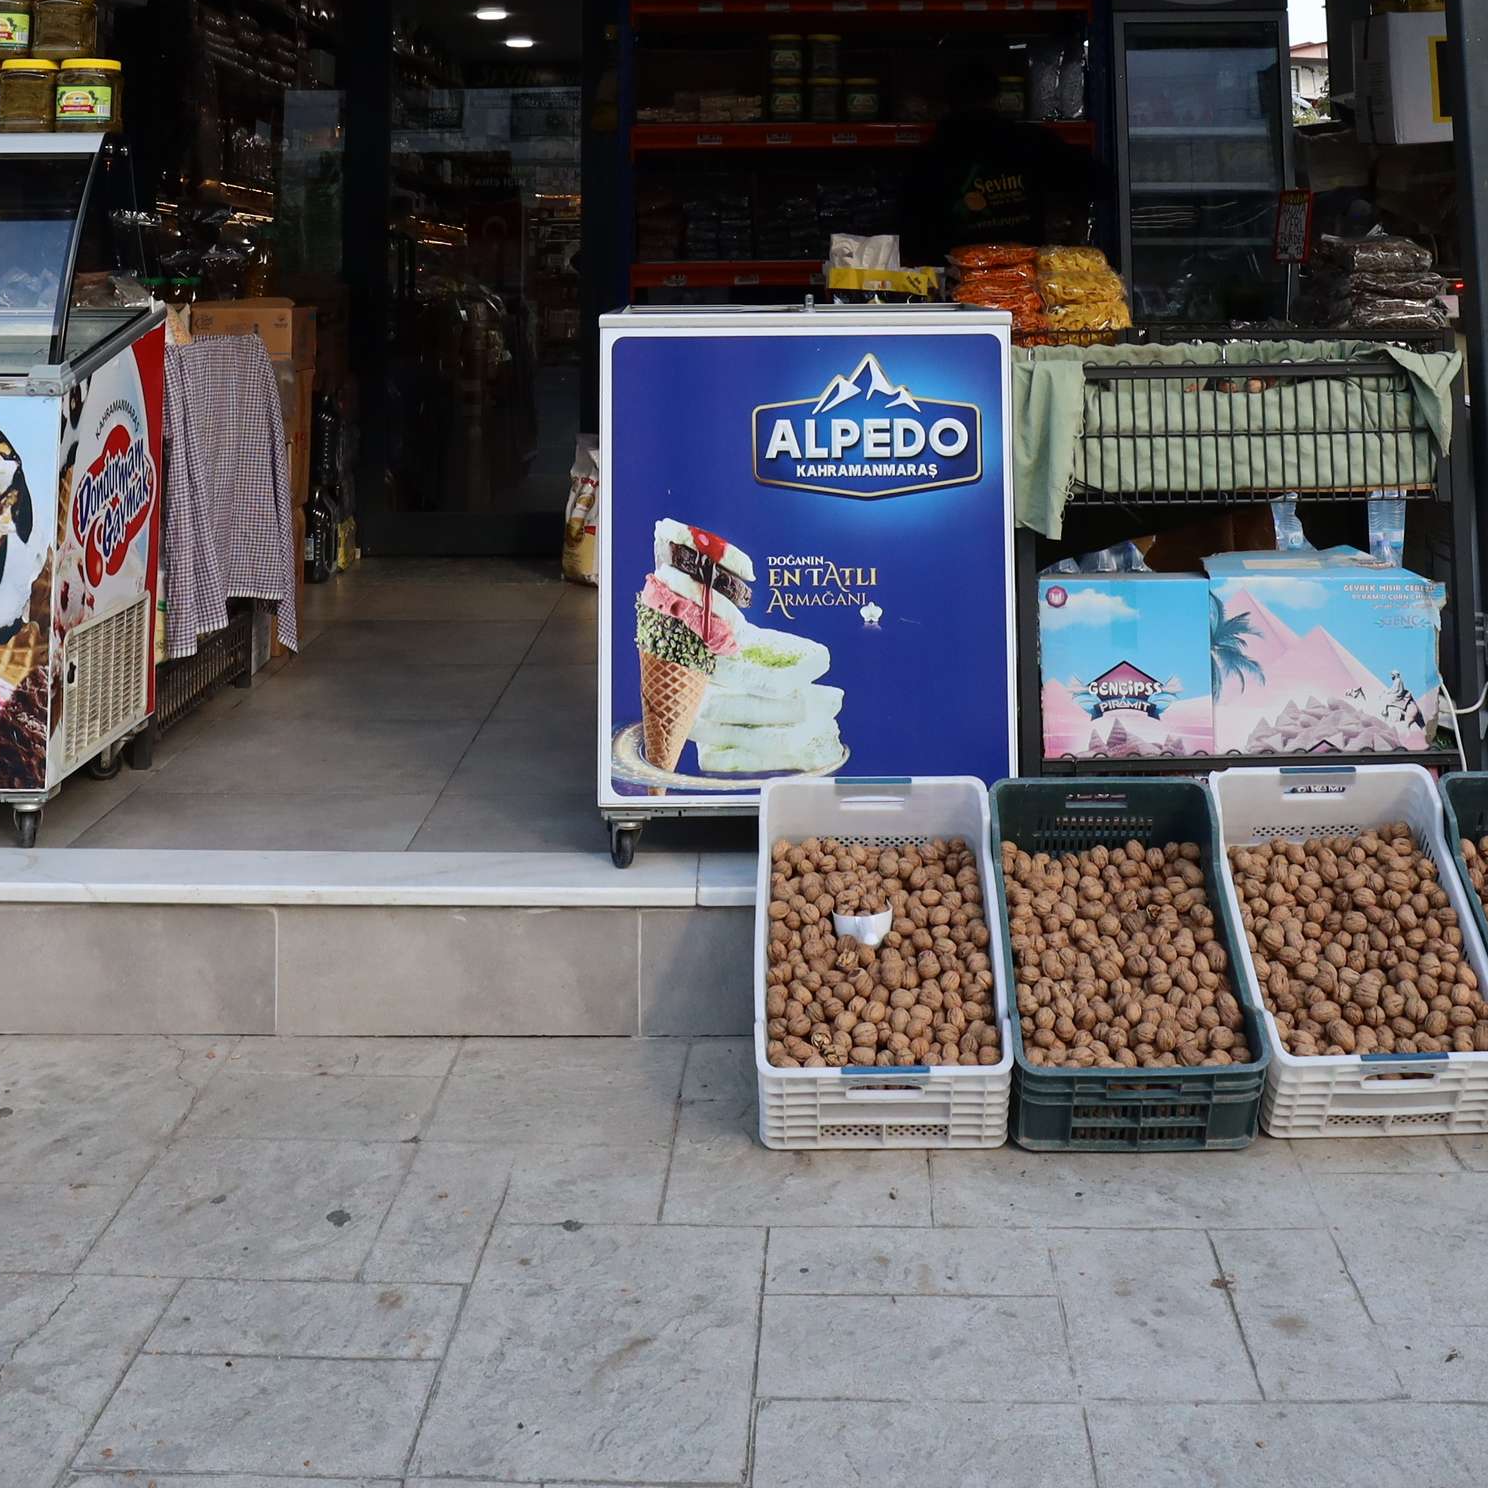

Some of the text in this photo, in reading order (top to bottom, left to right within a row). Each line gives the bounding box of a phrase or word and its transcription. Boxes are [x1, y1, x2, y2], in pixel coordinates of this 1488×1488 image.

[765, 417, 969, 458] ALPEDO
[79, 438, 145, 534] Dondurmam
[796, 463, 938, 478] KAHRAMANMARAŞ
[103, 469, 150, 557] Gaymak
[766, 554, 824, 566] DOĞANIN
[768, 561, 878, 592] EN TATLI
